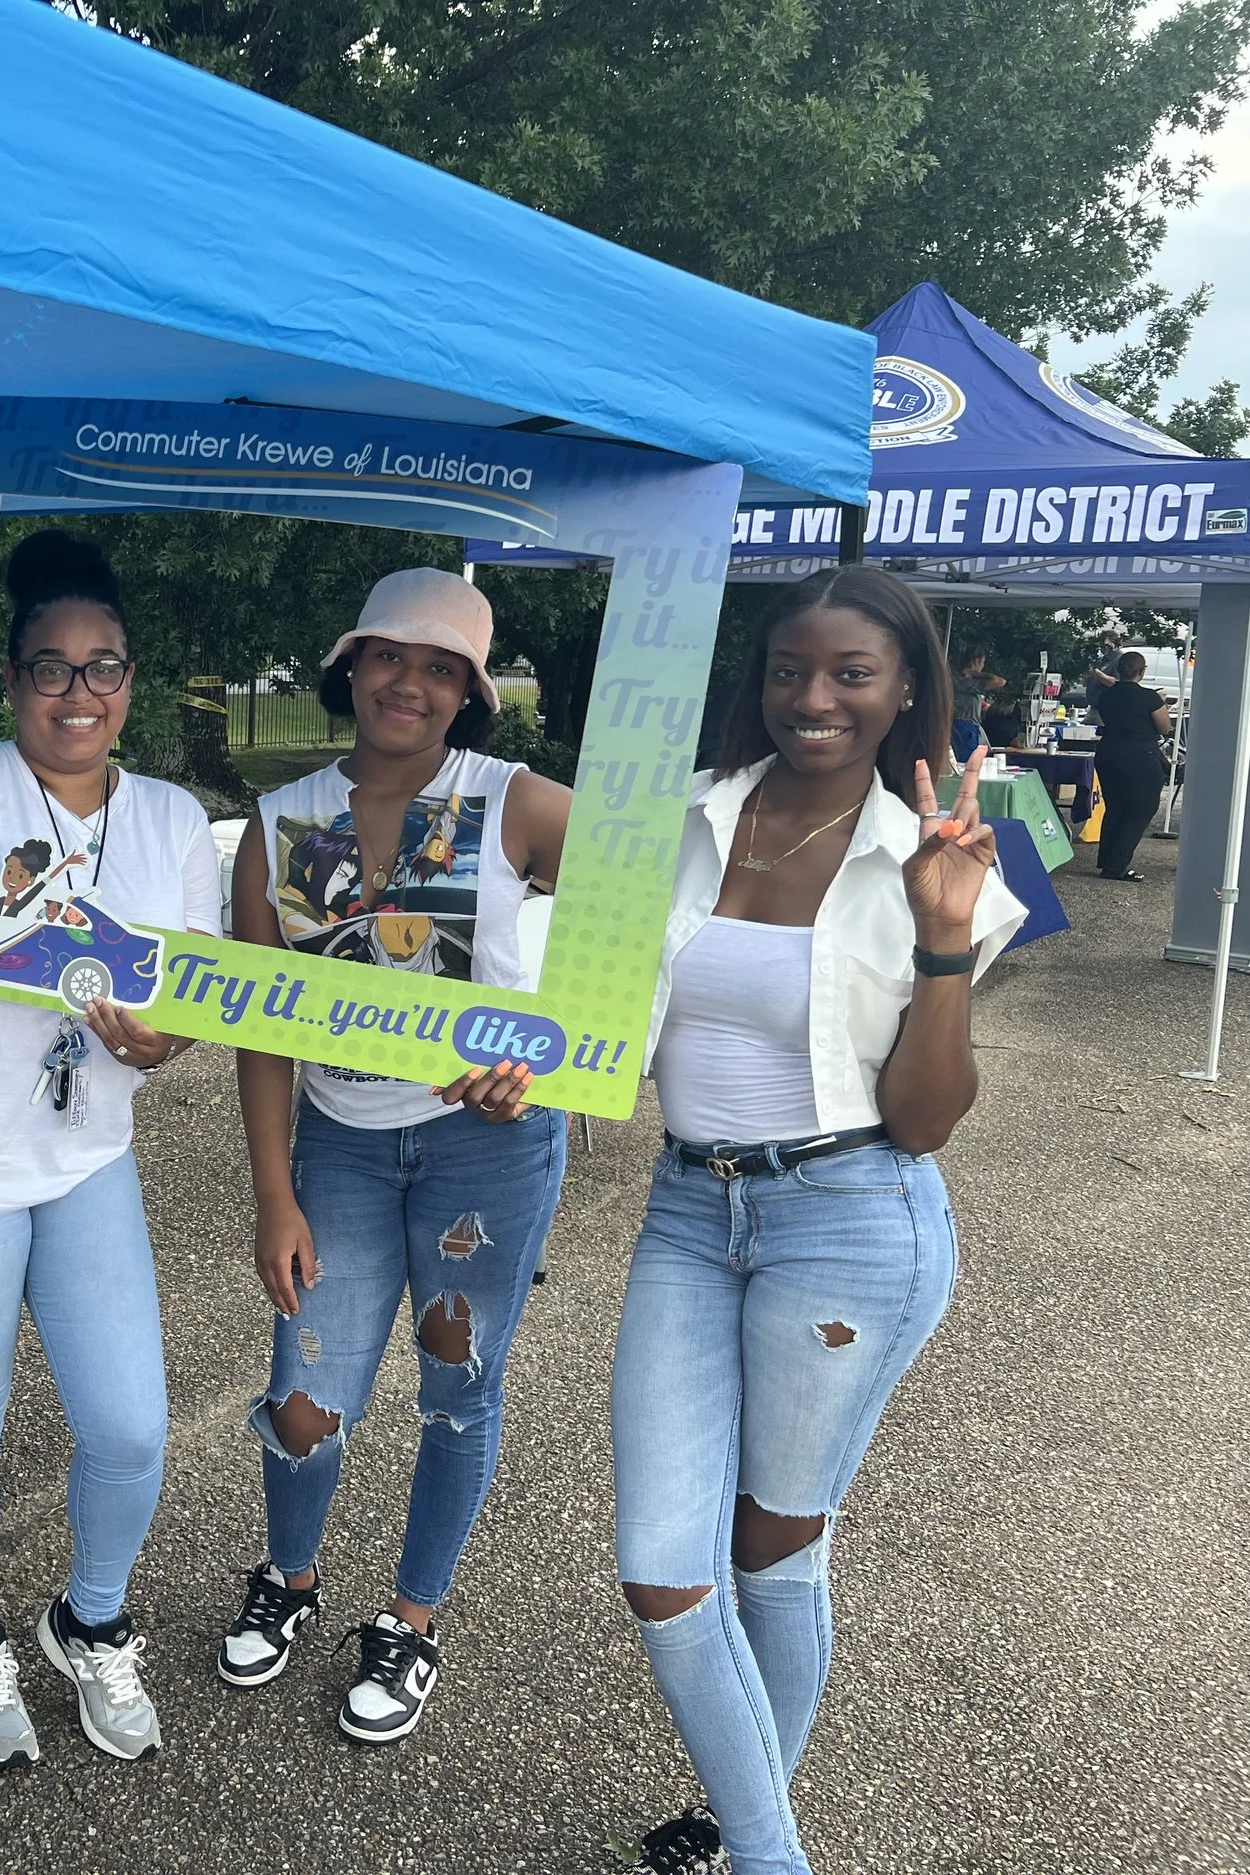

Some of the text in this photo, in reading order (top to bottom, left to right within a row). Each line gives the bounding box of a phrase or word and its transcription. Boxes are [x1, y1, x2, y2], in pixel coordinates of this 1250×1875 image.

[893, 364, 929, 381] BLACK
[76, 424, 229, 459] Commuter
[237, 433, 334, 468] Krewe
[344, 443, 373, 477] of
[380, 446, 533, 491] Louisiana
[981, 482, 1215, 544] DISTRICT
[1207, 519, 1244, 530] Eurmax
[599, 678, 699, 747] Try
[167, 953, 257, 1025] Try
[465, 1014, 552, 1062] like
[572, 1033, 628, 1075] it!
[323, 1069, 389, 1082] COWBOY
